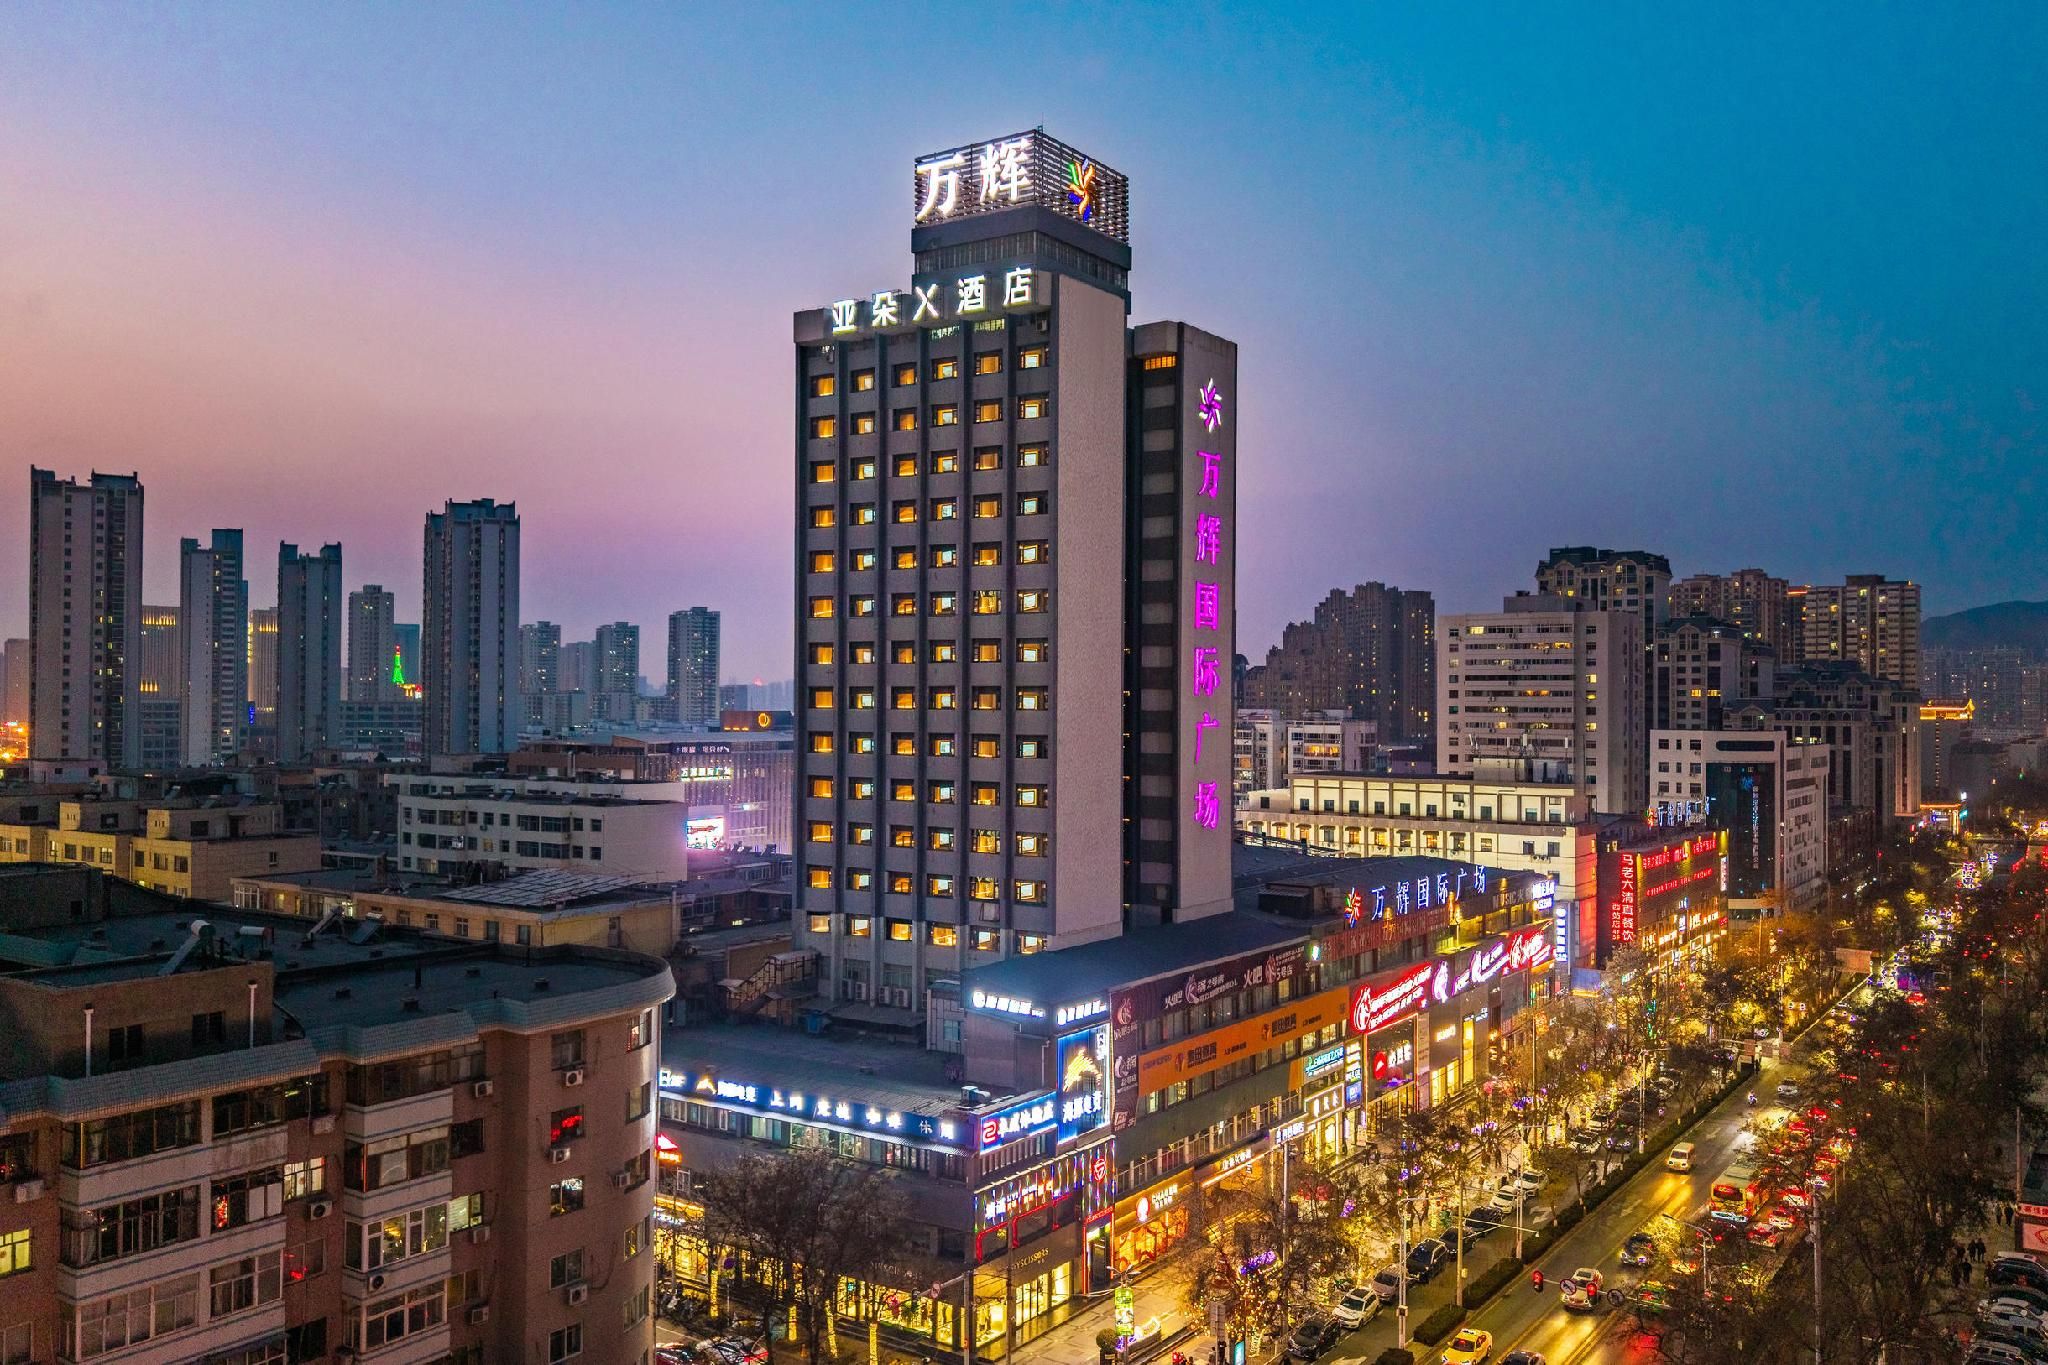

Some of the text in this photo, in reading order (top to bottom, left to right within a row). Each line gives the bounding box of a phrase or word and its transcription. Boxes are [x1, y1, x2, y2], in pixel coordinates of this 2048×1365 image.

[916, 138, 1030, 220] 万辉
[832, 267, 1033, 334] 亚朵X酒店
[1195, 451, 1221, 829] 万辉国际广场
[1371, 865, 1487, 921] 万辉国际广场
